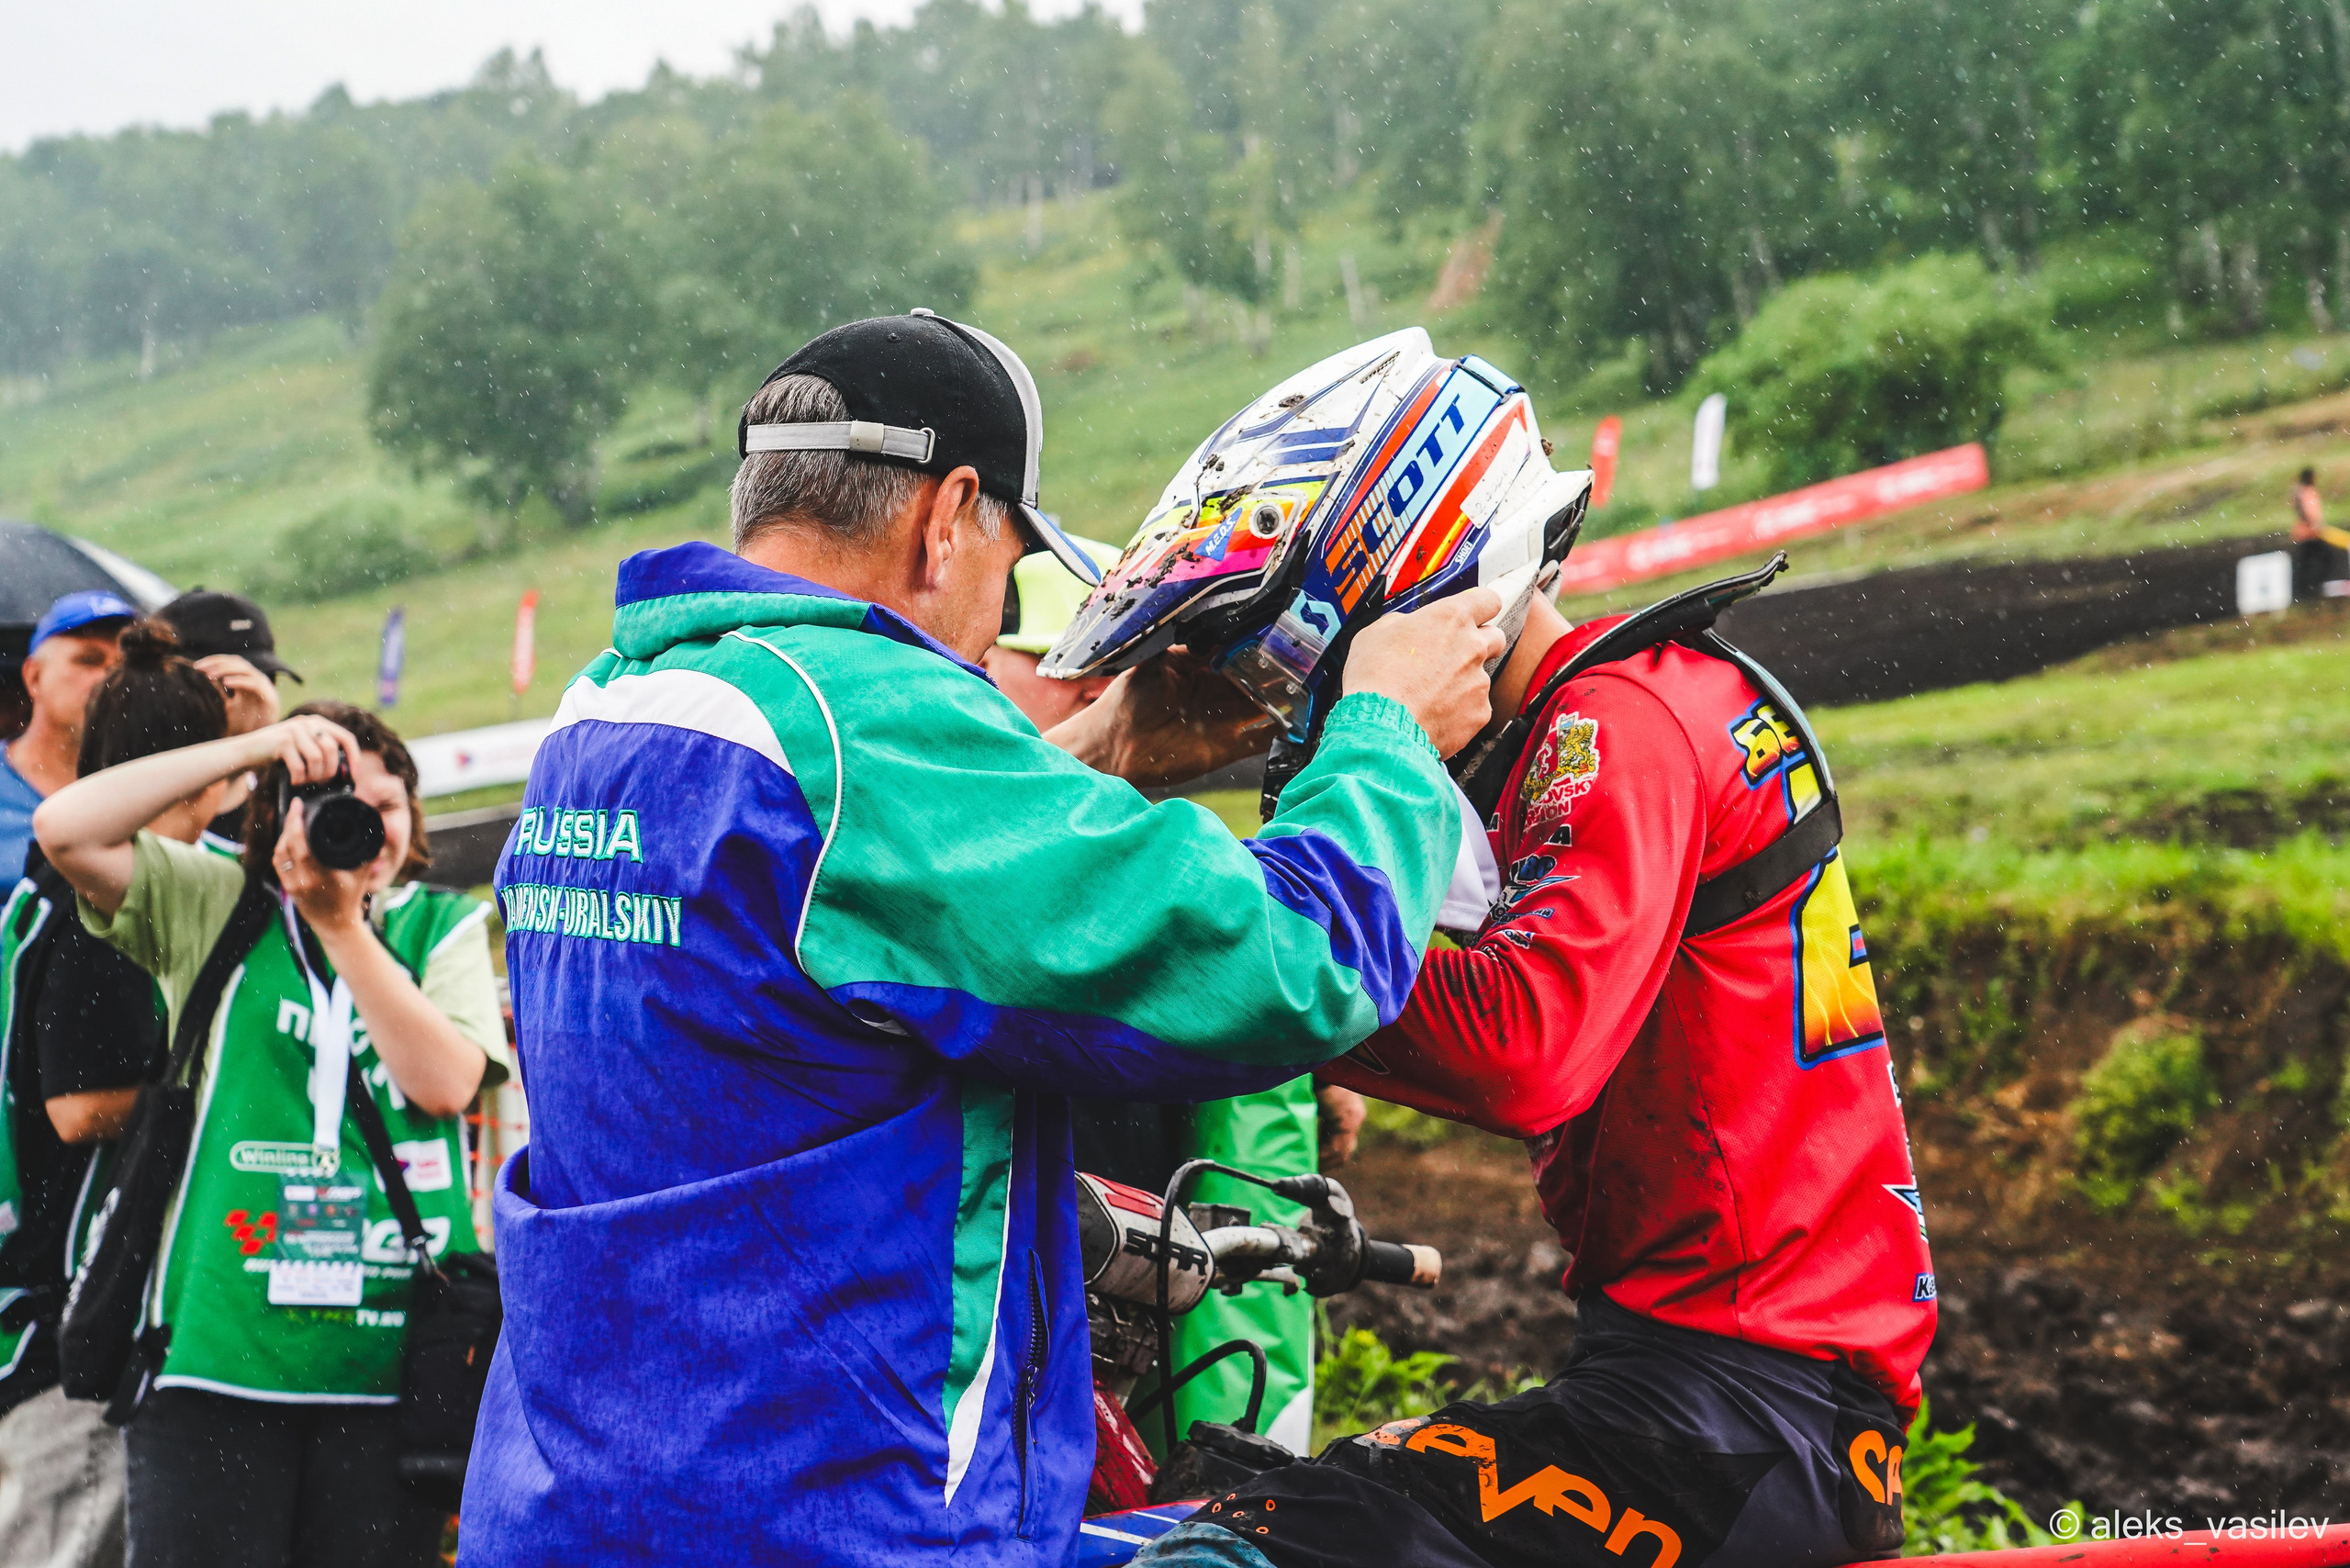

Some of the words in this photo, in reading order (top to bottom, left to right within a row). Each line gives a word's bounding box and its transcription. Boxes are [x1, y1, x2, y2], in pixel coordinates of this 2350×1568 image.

[1325, 393, 1469, 614] SCOTT
[1455, 540, 1473, 565] SHOEI
[513, 806, 643, 864] RUSSIA
